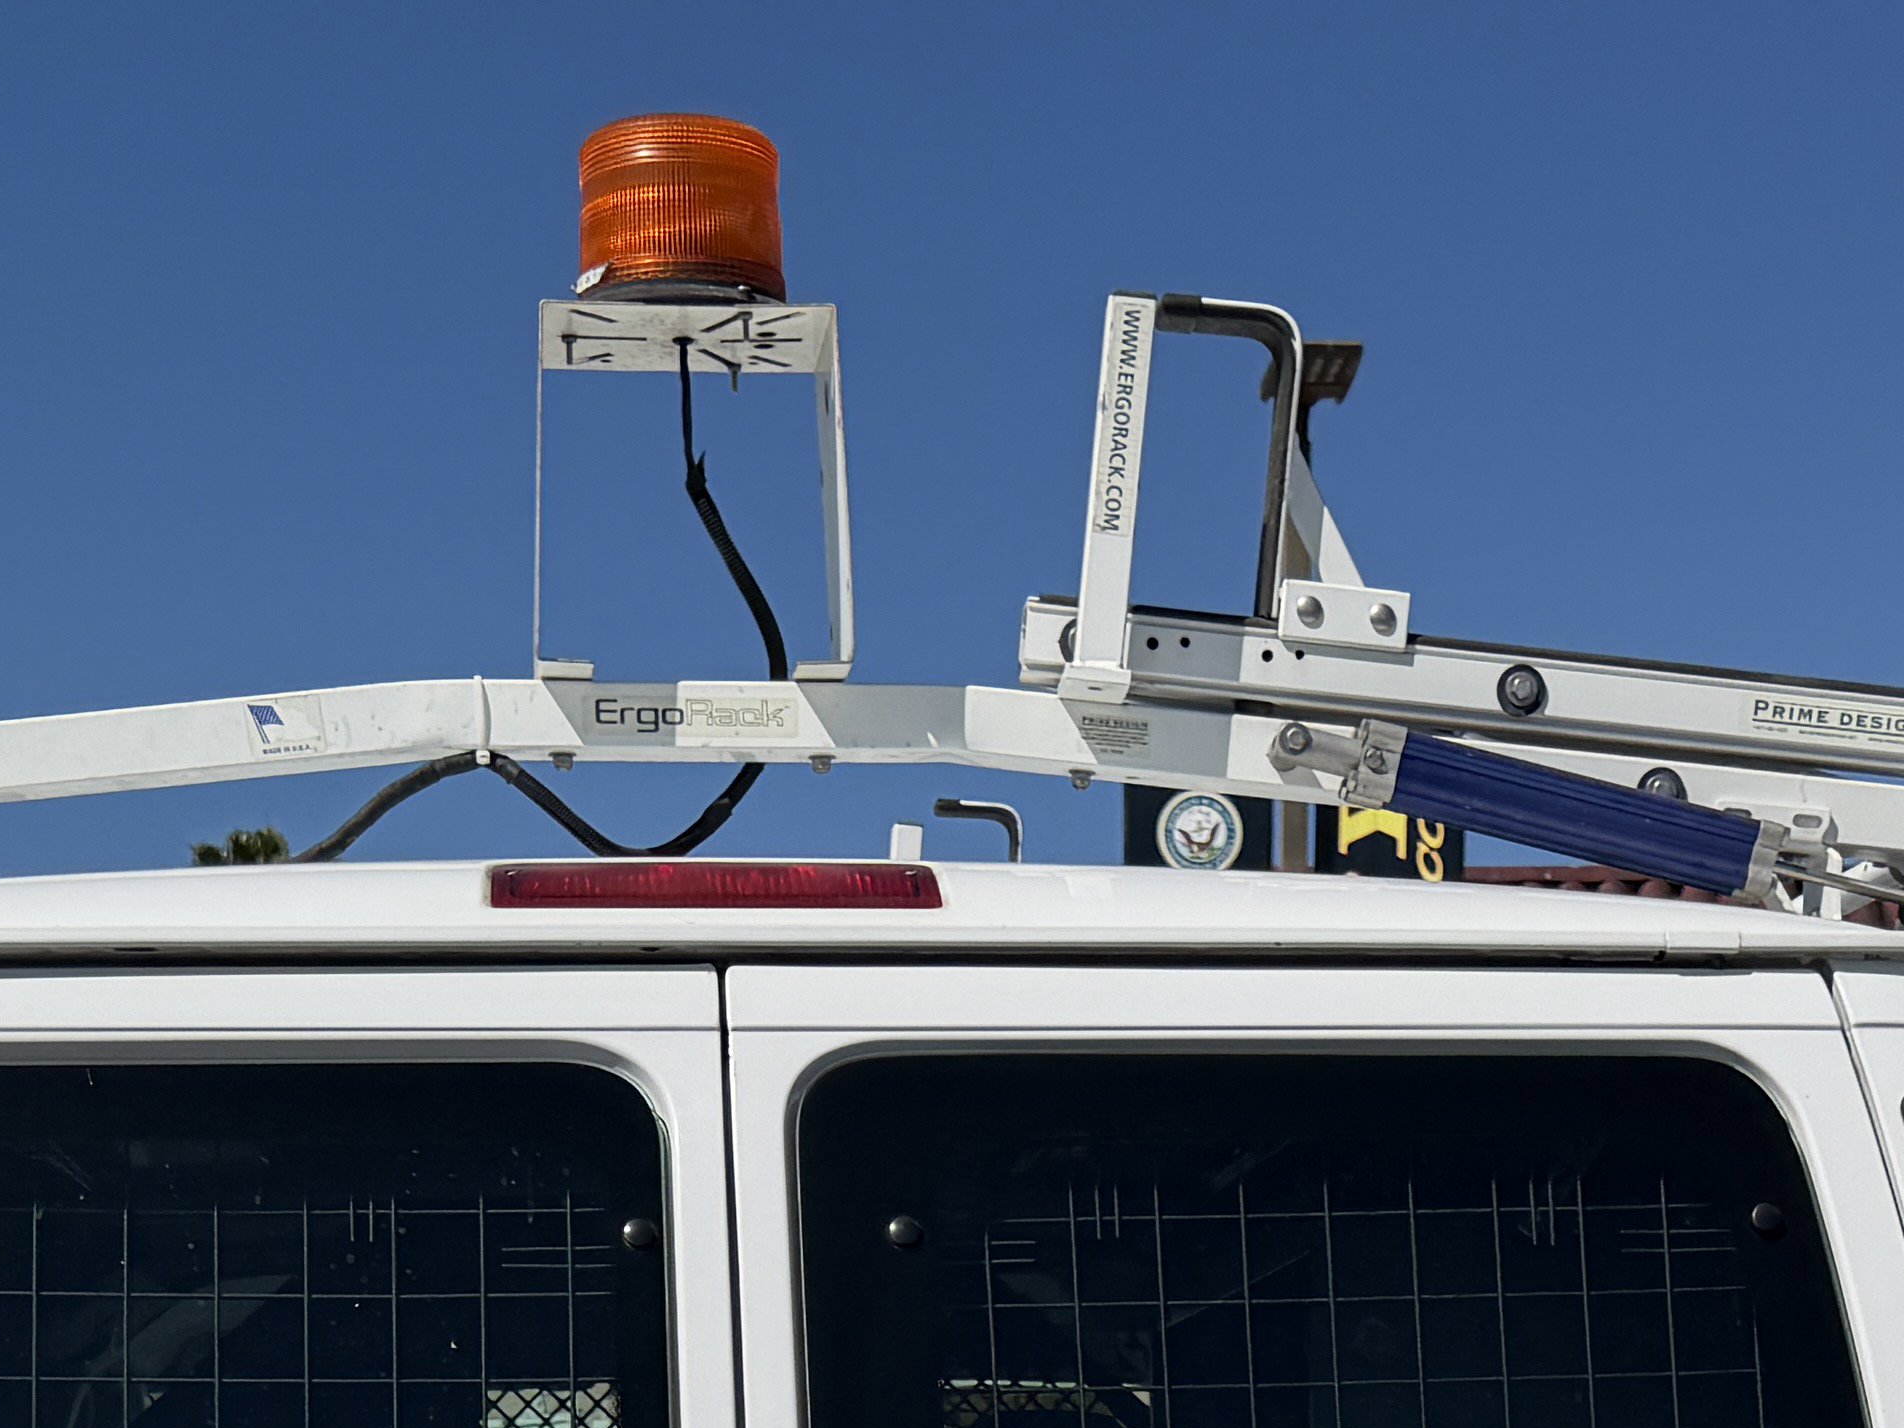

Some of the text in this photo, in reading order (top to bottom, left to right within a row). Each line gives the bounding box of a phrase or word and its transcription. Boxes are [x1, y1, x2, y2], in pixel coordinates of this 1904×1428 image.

[1103, 310, 1141, 532] WWW.ERGORACK.COM
[595, 698, 784, 732] ErgoRack
[1753, 699, 1830, 724] PRIME
